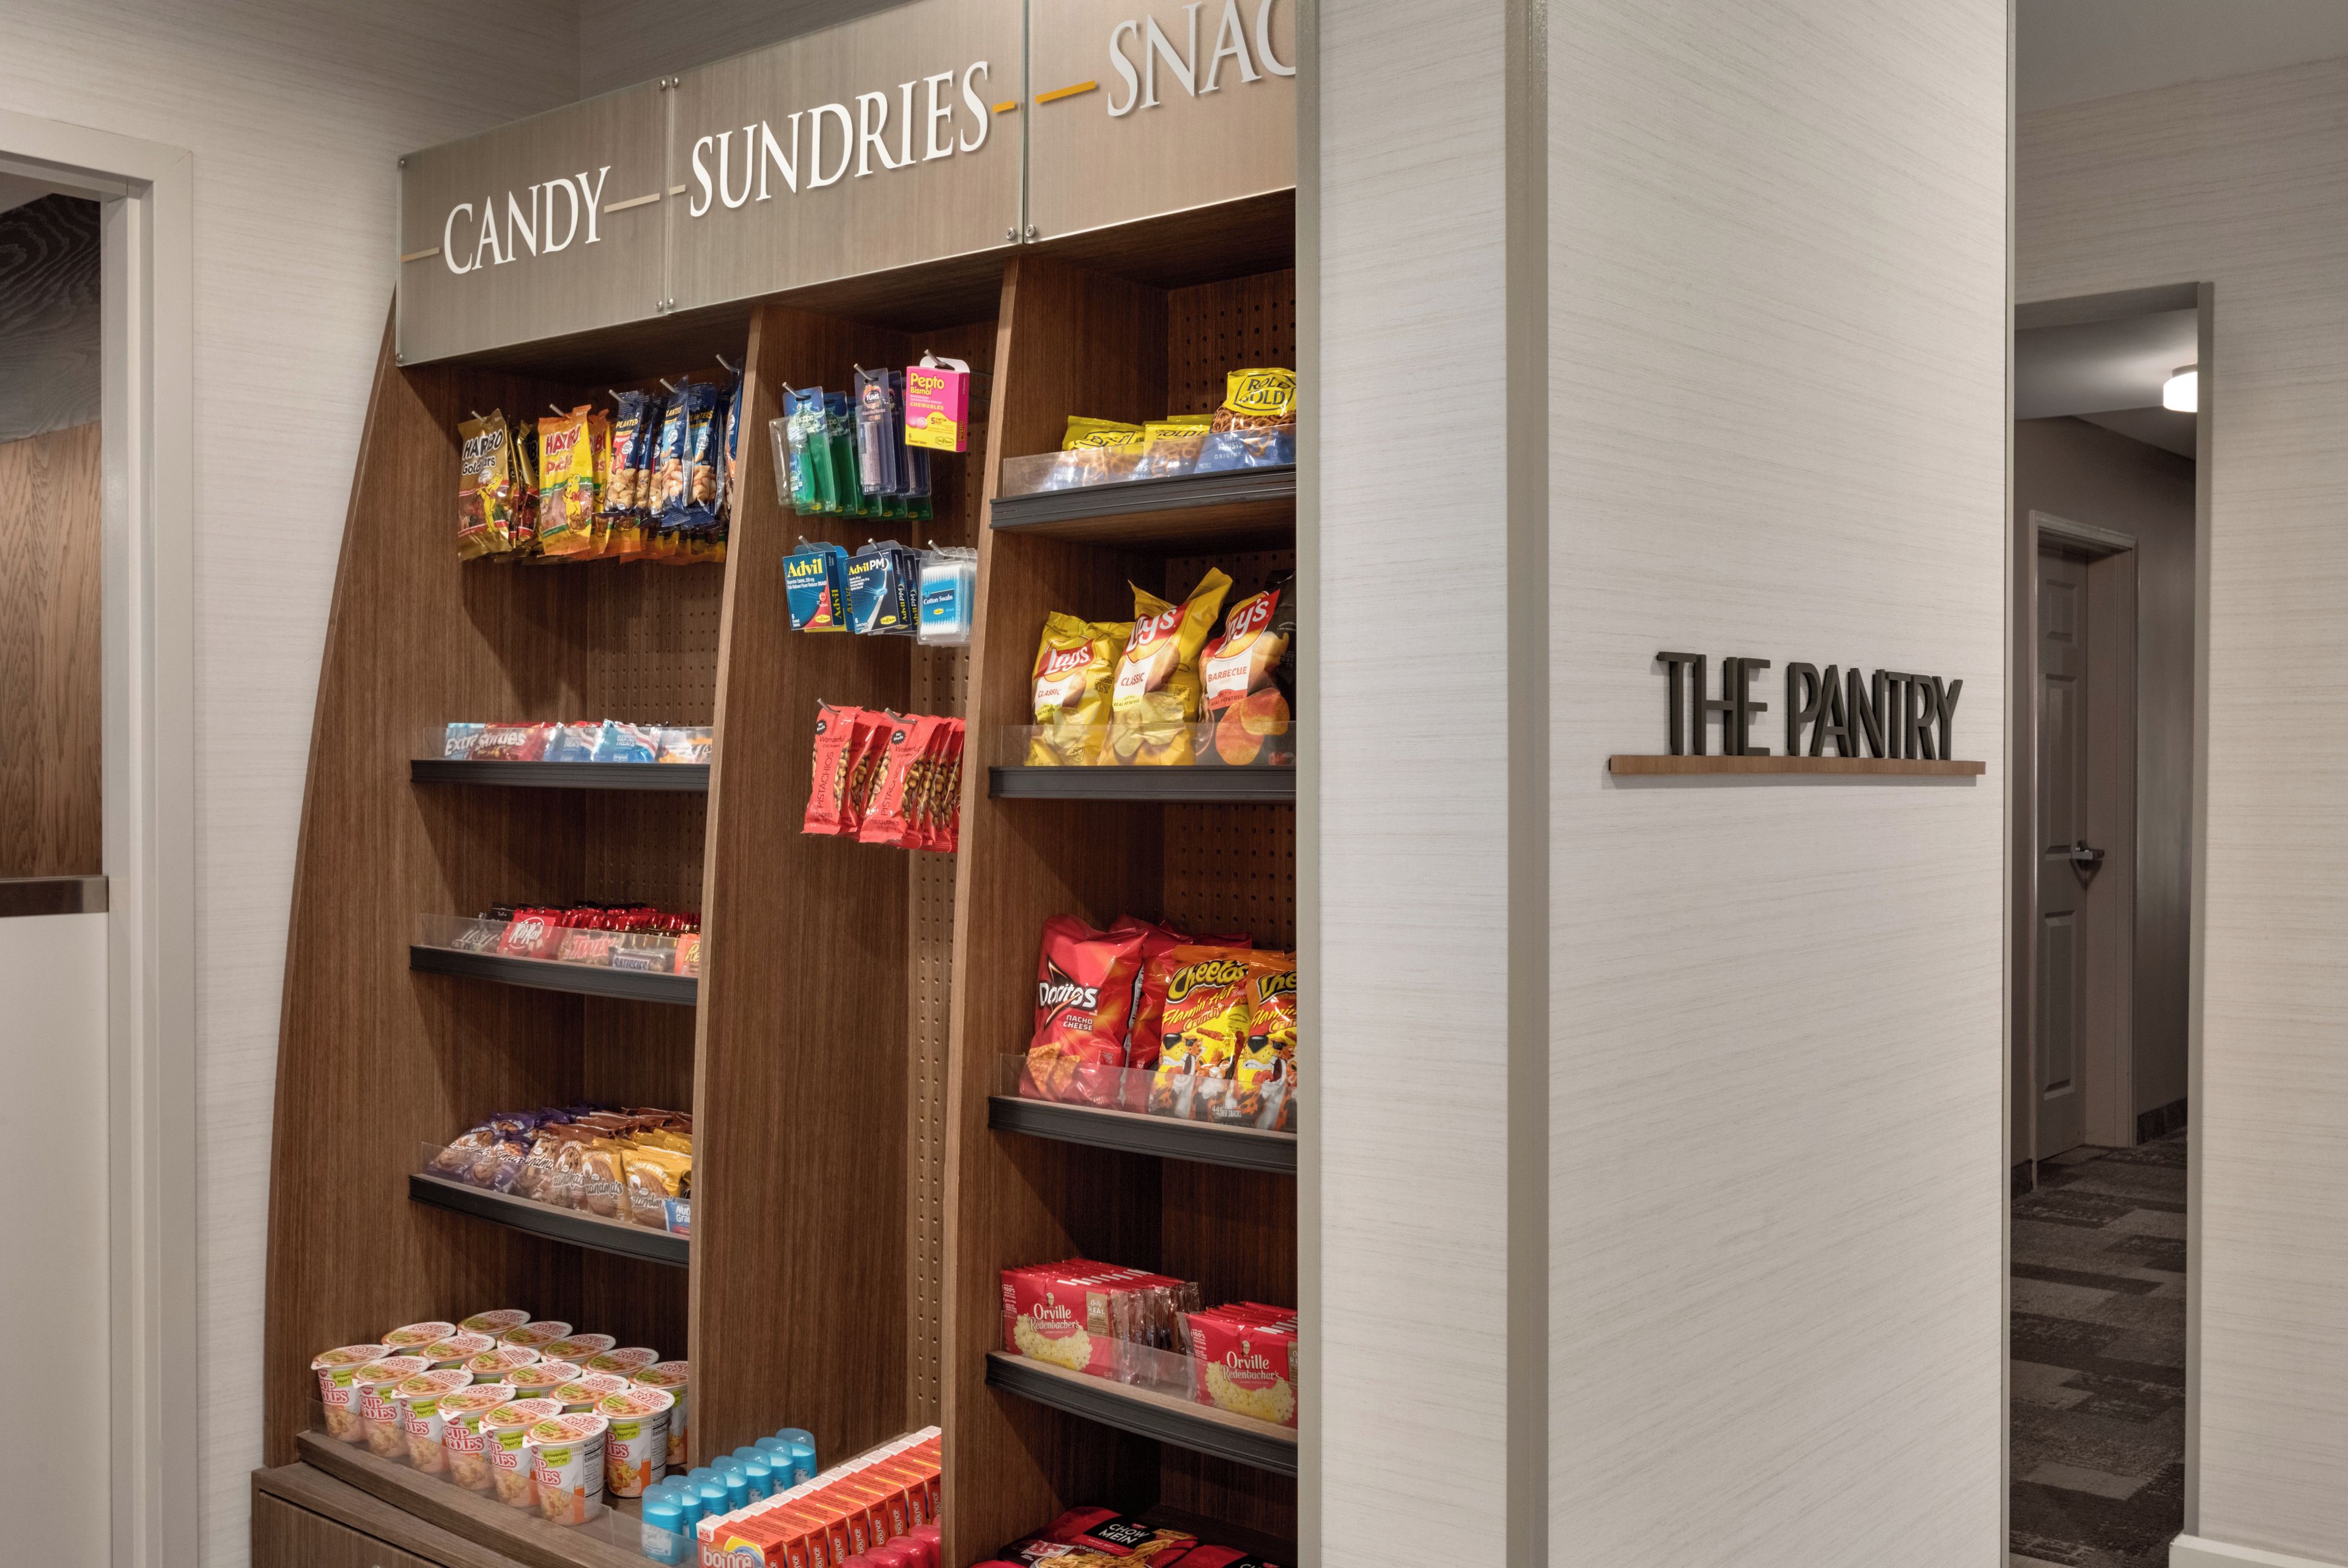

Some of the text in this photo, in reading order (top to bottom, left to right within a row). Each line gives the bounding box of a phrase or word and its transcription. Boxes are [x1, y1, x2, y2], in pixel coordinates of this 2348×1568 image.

[690, 61, 988, 218] SUNDRIES
[443, 166, 611, 274] CANDY
[910, 372, 945, 390] Pepto
[1247, 377, 1291, 391] ROLD
[910, 386, 932, 396] Bismol
[1239, 389, 1286, 405] GOLD
[462, 429, 504, 460] HARBO
[462, 455, 496, 476] Goldars
[787, 558, 823, 577] Advil
[832, 589, 841, 619] Advil
[1121, 672, 1145, 686] CLASSIC
[1208, 666, 1247, 683] BARBECUE
[1038, 689, 1061, 698] CLASSIC
[1220, 694, 1243, 704] POTATOES
[1656, 651, 1964, 760] THE PANTRY
[817, 752, 833, 808] PISTACHIOS
[881, 760, 903, 815] PISTAC
[1168, 960, 1249, 1000] Cheetos
[1039, 982, 1098, 1008] Doritos
[1209, 984, 1236, 1005] Hot
[1063, 1021, 1093, 1031] CHEESE
[1066, 1015, 1093, 1025] NACHO
[1183, 1004, 1225, 1032] Crunchy
[586, 1178, 624, 1198] randma's
[676, 1205, 690, 1216] Nut
[676, 1214, 690, 1223] Gra
[1033, 1303, 1071, 1320] Orville
[1088, 1306, 1106, 1315] REAL
[1028, 1316, 1080, 1333] Redenbacher's
[1227, 1351, 1269, 1369] Orville
[1220, 1364, 1280, 1382] Redenbacher's
[322, 1391, 349, 1404] DLES
[360, 1395, 383, 1407] CUP
[645, 1391, 669, 1401] CUP
[361, 1407, 397, 1420] ODLES
[402, 1410, 416, 1422] UP
[580, 1416, 602, 1425] CUP
[405, 1421, 429, 1435] DLES
[445, 1426, 471, 1440] CUP
[446, 1438, 484, 1452] ODLES
[489, 1443, 503, 1455] UP
[492, 1454, 517, 1468] DLES
[533, 1458, 547, 1470] UP
[536, 1470, 561, 1484] DLES
[893, 1508, 903, 1535] bounce
[875, 1518, 885, 1545] bounce
[1098, 1528, 1138, 1545] MEIN
[1109, 1523, 1150, 1538] CHOW
[855, 1526, 865, 1555] bounce
[834, 1537, 844, 1564] bounce
